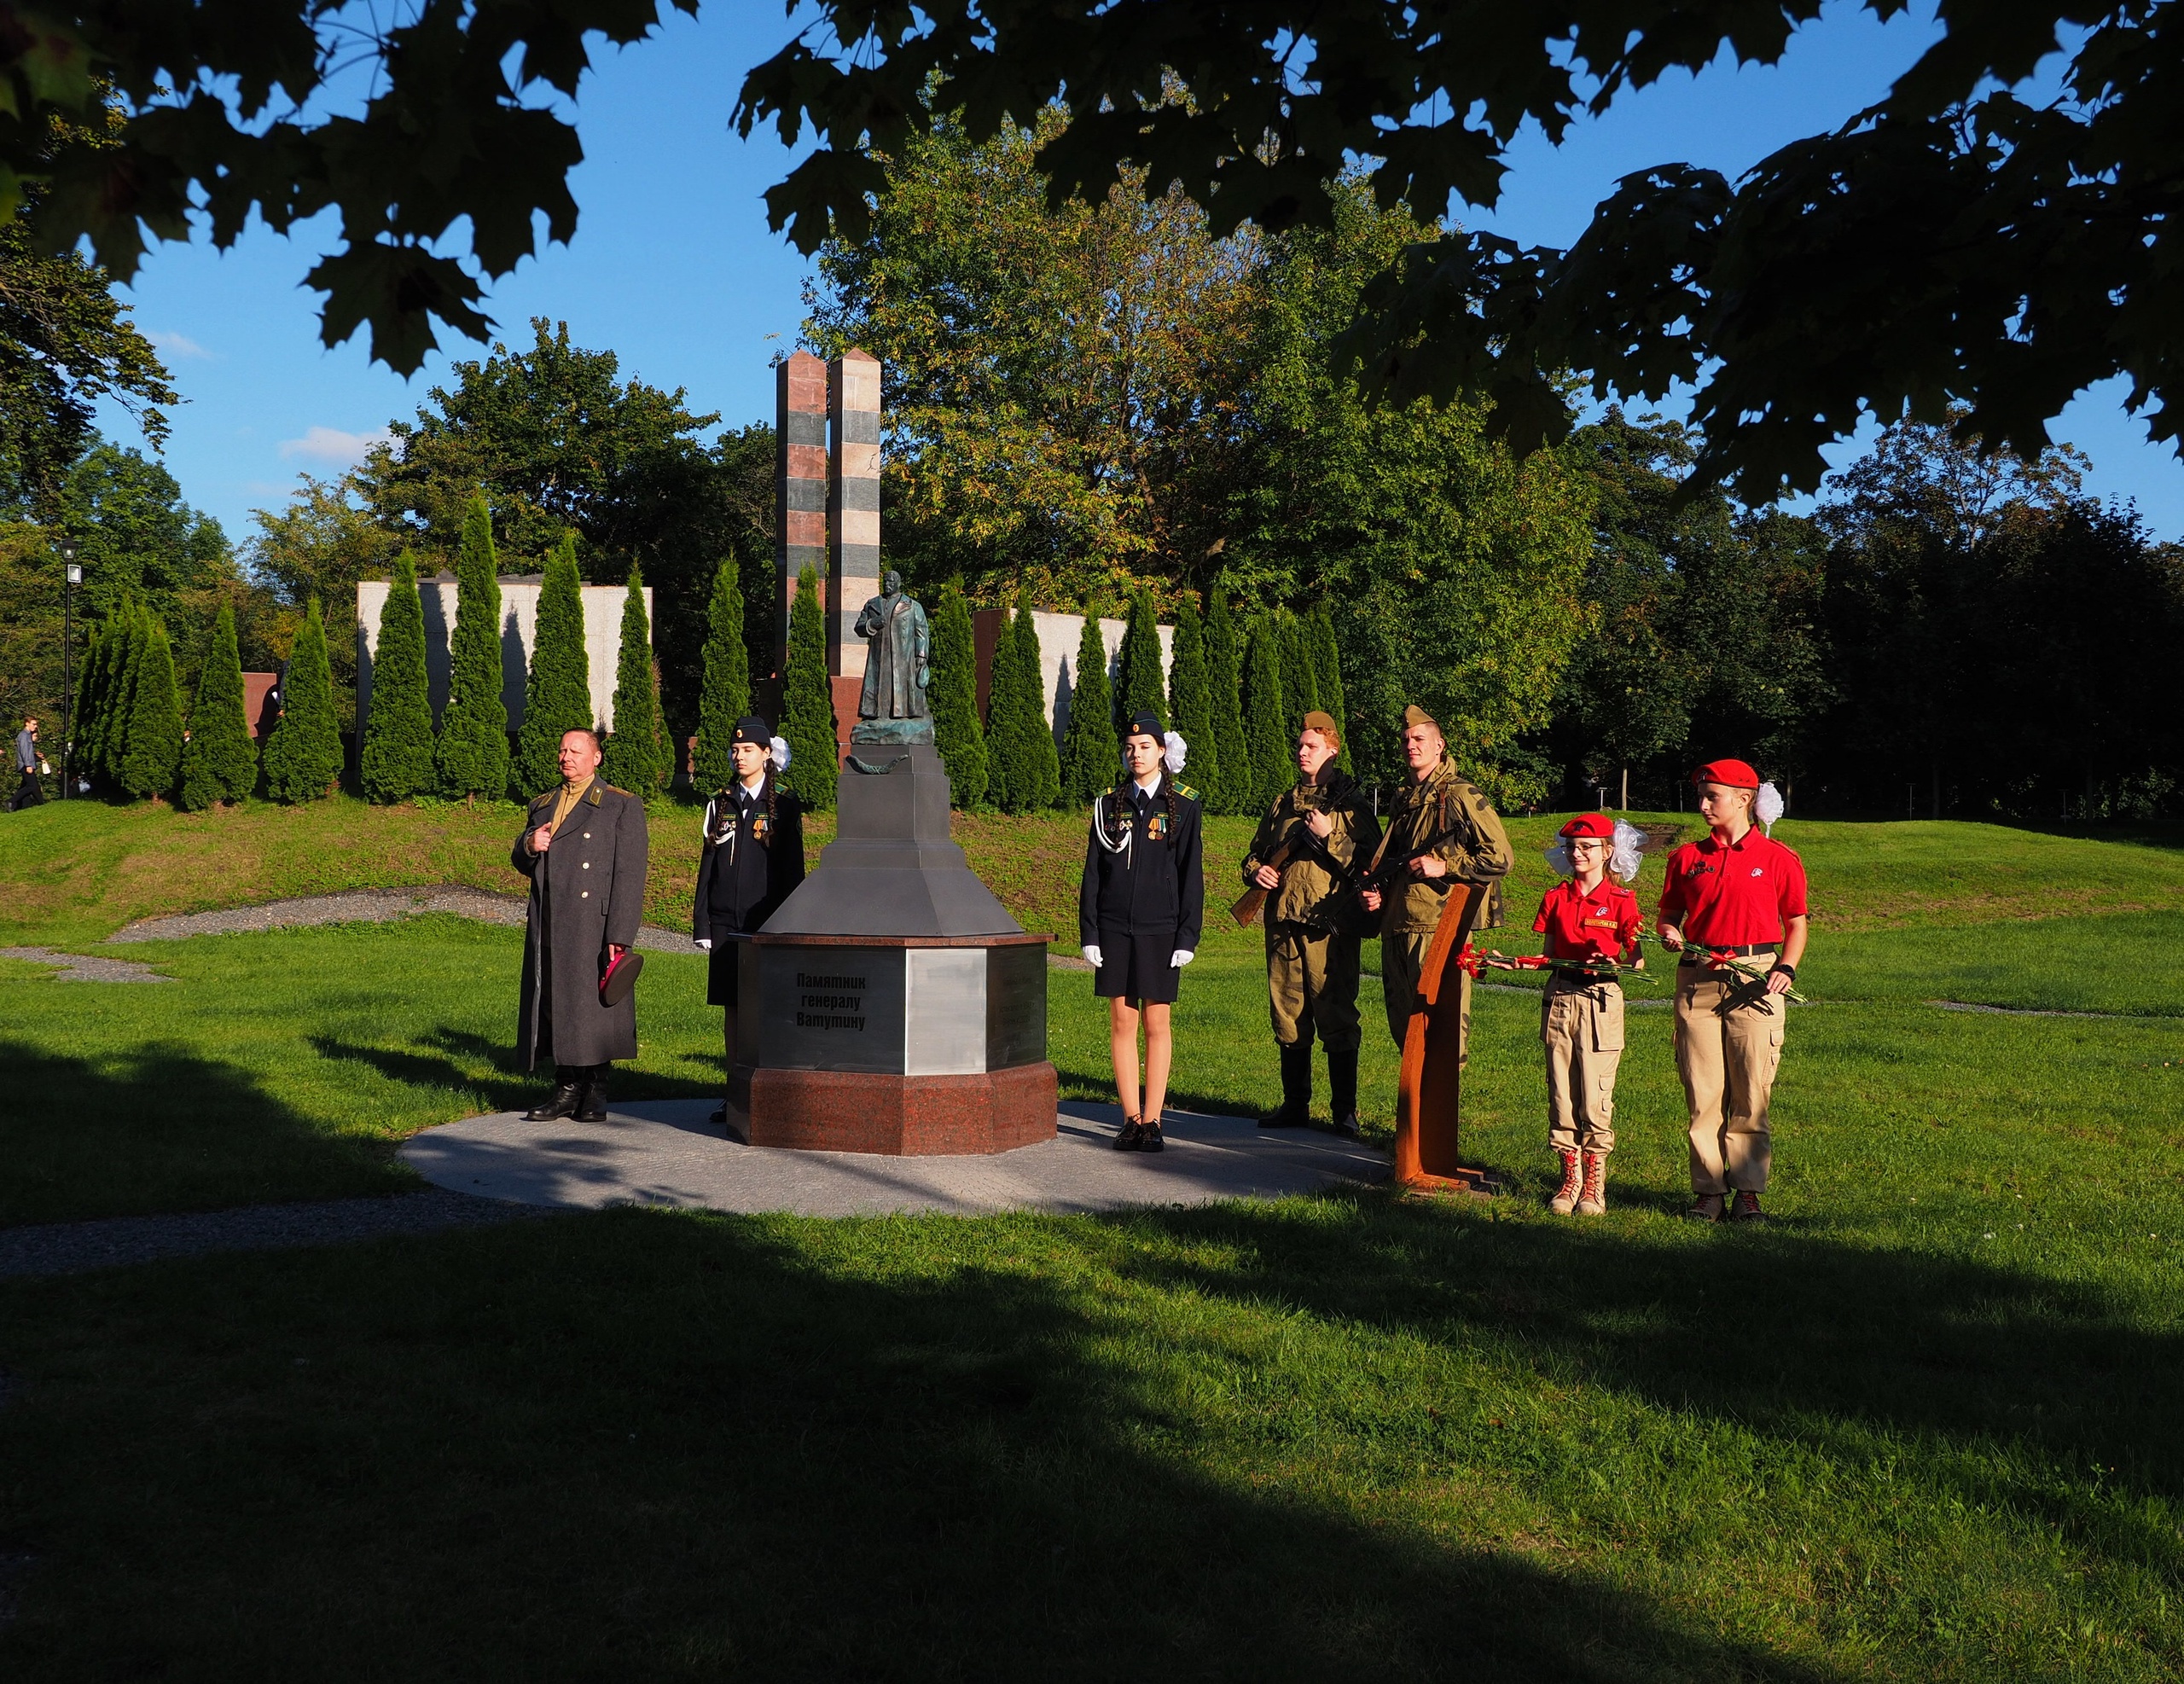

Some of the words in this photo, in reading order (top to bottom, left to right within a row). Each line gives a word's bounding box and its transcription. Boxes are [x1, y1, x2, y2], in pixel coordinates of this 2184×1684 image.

[797, 973, 866, 990] Памятник
[801, 995, 861, 1012] генералу
[796, 1011, 866, 1032] Ватутину
